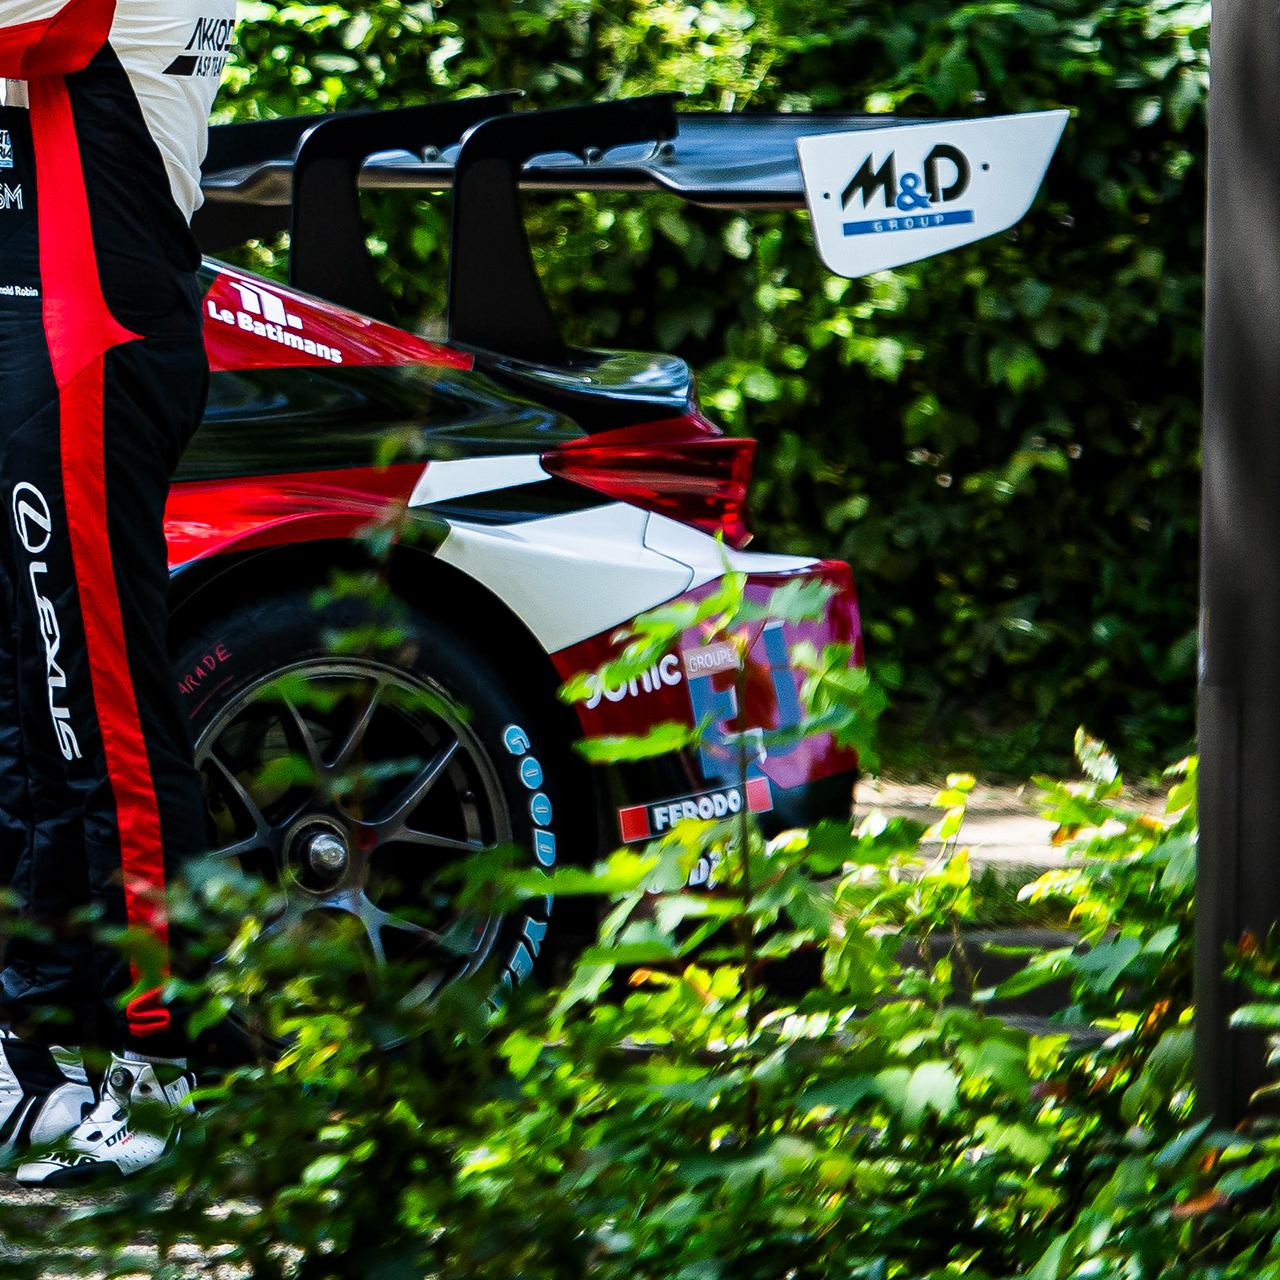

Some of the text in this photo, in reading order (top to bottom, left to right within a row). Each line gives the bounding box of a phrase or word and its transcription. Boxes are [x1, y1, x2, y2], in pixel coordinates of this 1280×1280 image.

[871, 213, 947, 234] GROUP
[14, 285, 39, 297] Robin
[206, 299, 343, 364] Le Batimans
[29, 561, 83, 761] LEXUS
[689, 646, 737, 674] GROUPE
[652, 788, 742, 832] FERODO
